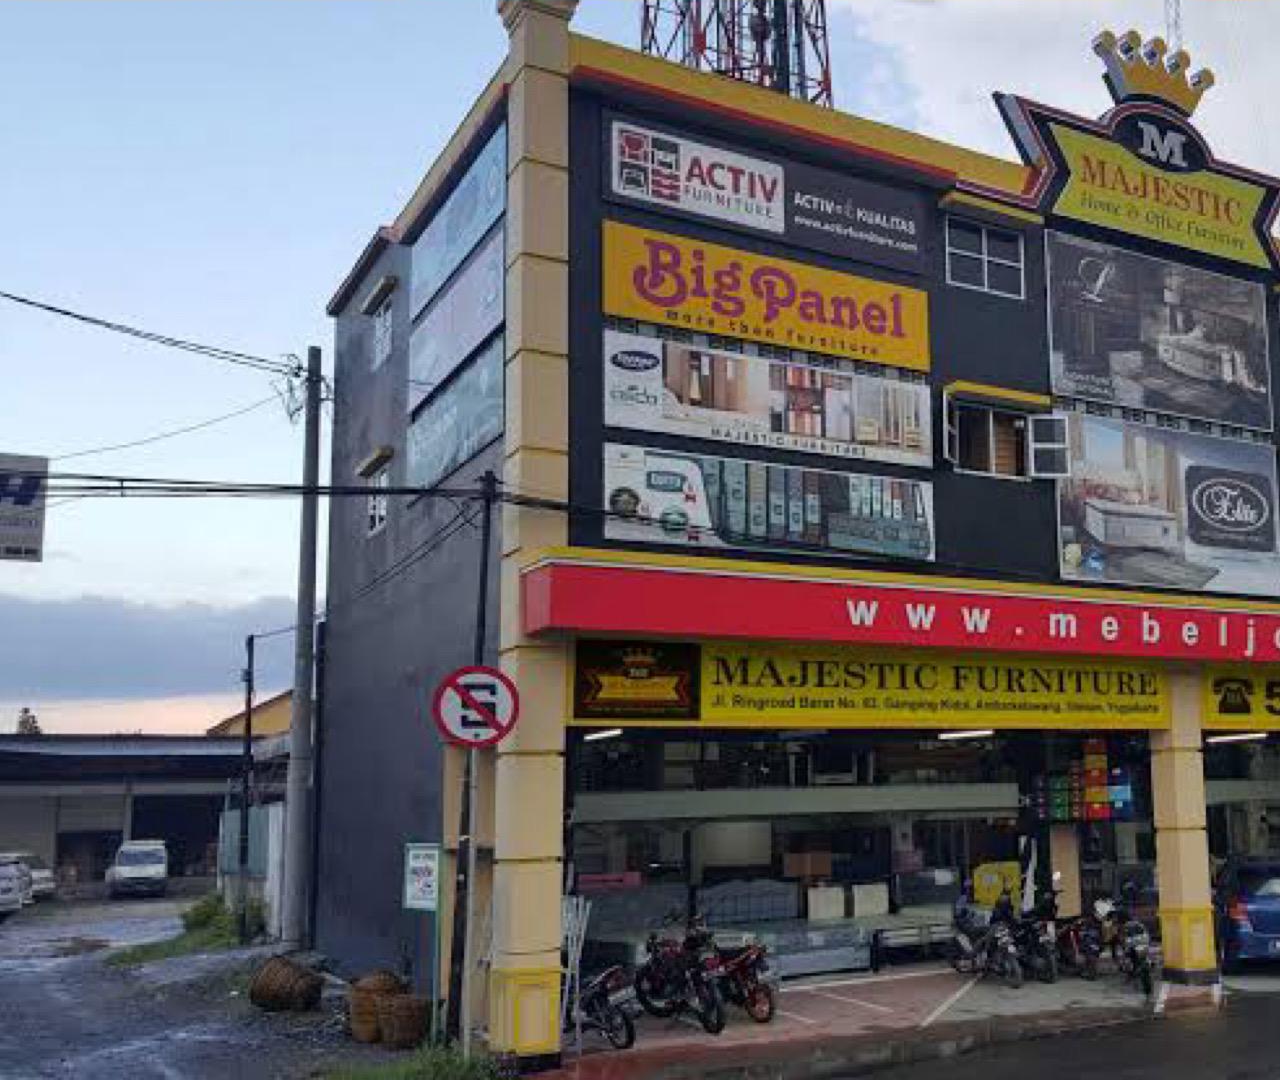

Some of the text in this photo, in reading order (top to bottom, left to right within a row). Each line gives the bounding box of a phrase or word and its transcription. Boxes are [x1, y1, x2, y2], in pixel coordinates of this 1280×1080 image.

[1138, 120, 1188, 167] M
[686, 156, 778, 203] ACTIV
[1080, 153, 1243, 226] MAJESTIC
[711, 655, 939, 694] MAJESTIC
[951, 664, 1159, 697] FURNITURE
[732, 695, 796, 711] Ringroad
